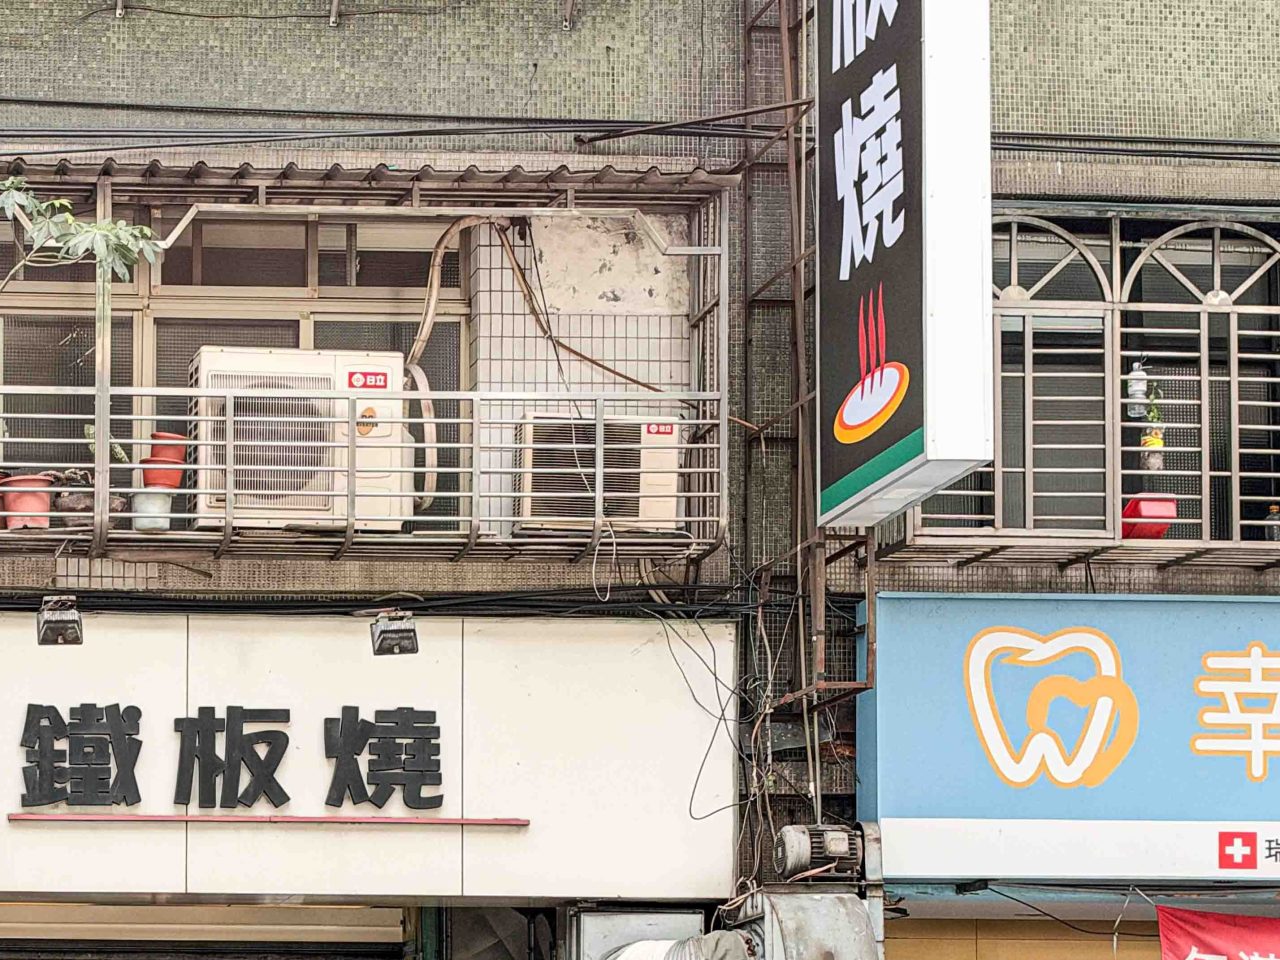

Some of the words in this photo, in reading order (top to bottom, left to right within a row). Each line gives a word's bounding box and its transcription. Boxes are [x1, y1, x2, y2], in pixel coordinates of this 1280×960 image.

[366, 374, 385, 386] 日立
[20, 702, 445, 812] 鐵板燒
